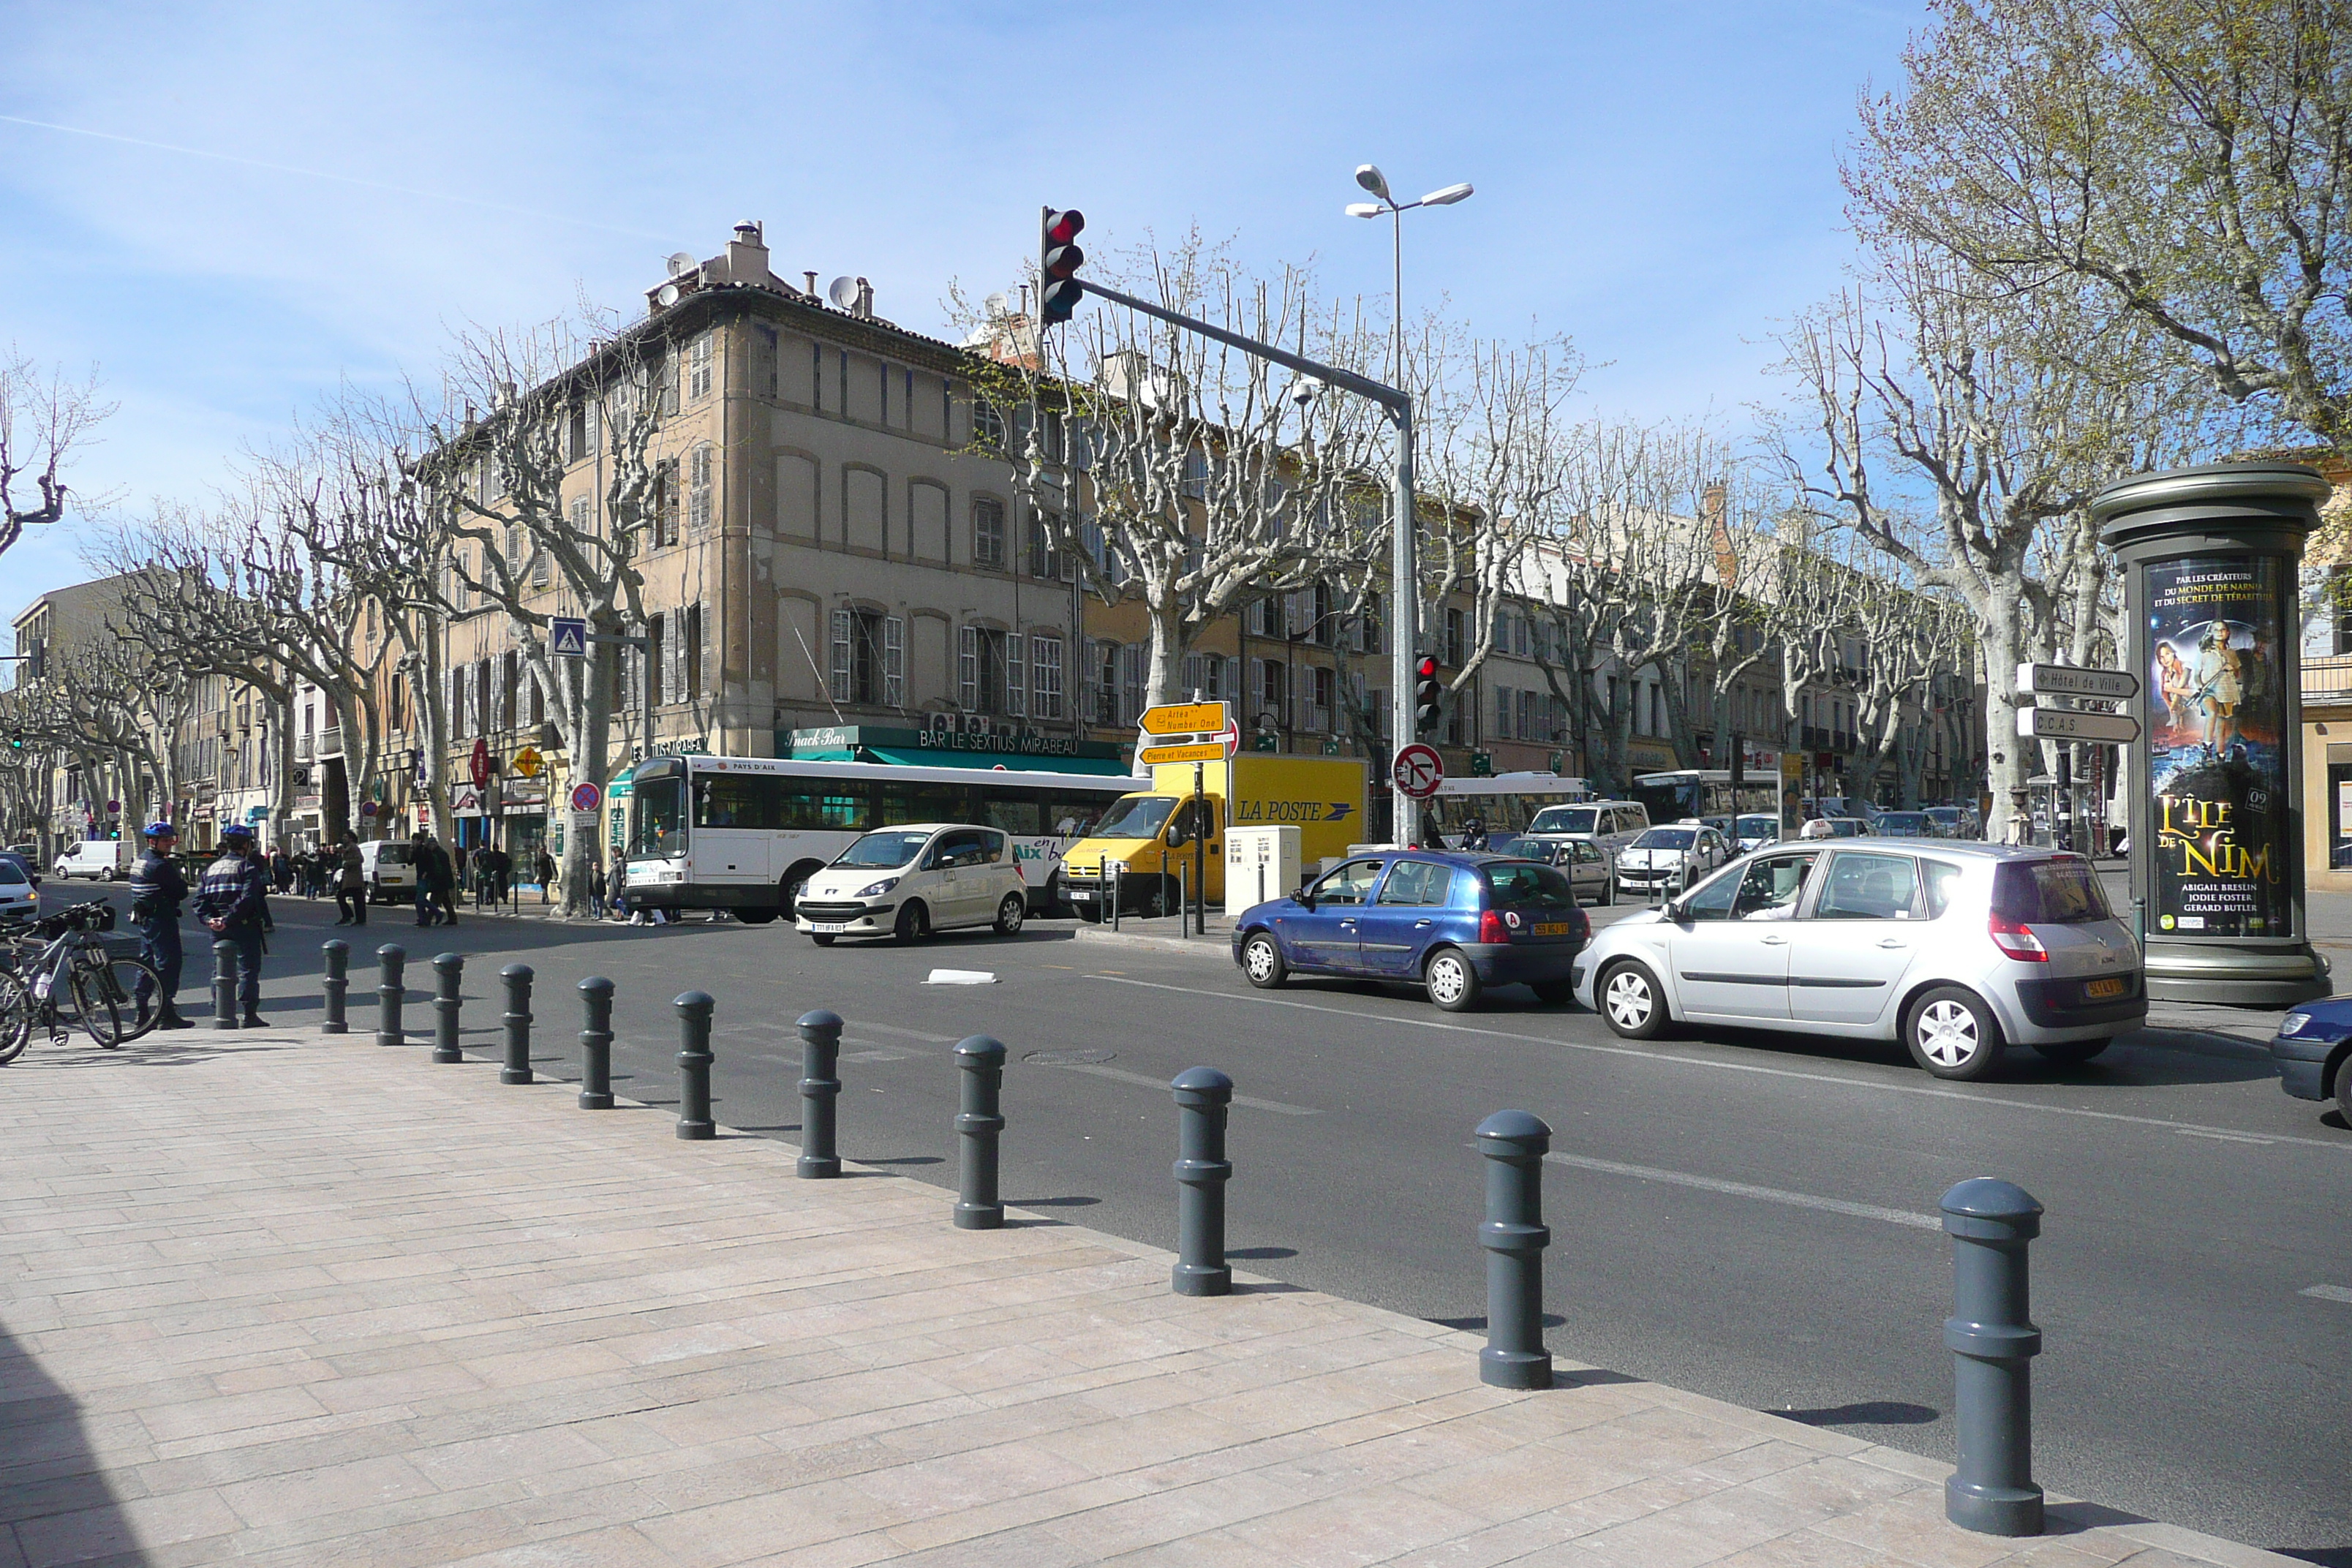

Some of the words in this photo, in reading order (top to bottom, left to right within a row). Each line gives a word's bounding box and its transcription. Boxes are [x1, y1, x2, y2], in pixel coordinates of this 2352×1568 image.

[2176, 576, 2192, 584] PAR
[2192, 575, 2206, 583] LES
[2206, 572, 2252, 582] CRÉATEURS
[2165, 587, 2176, 596] DU
[2178, 584, 2214, 595] MONDE
[2216, 584, 2228, 592] DE
[2231, 583, 2263, 592] NARNIA
[2155, 599, 2163, 607] ET
[2164, 598, 2176, 606] DU
[2176, 595, 2209, 604] SECRET
[2211, 594, 2223, 602] DE
[2051, 673, 2078, 687] Hôtel
[2083, 676, 2094, 689] de
[2099, 676, 2121, 691] Ville
[1167, 720, 1197, 729] Number
[1200, 719, 1215, 728] One
[785, 728, 821, 747] Snack
[821, 728, 845, 746] Bar
[920, 731, 946, 748] BAR
[951, 733, 965, 749] LE
[970, 734, 1015, 752] SEXTIUS
[1020, 738, 1078, 755] MIRABEAU
[1147, 752, 1166, 761] Pierre
[1177, 749, 1207, 758] Vacances
[2250, 791, 2266, 804] 09
[1238, 800, 1262, 821] LA
[1266, 801, 1322, 821] POSTE
[1034, 839, 1049, 847] en
[2157, 834, 2176, 848] DE
[2189, 894, 2217, 902] JODIE
[2184, 904, 2221, 912] GERARD
[2224, 904, 2257, 912] BUTLER
[1509, 914, 1518, 925] A
